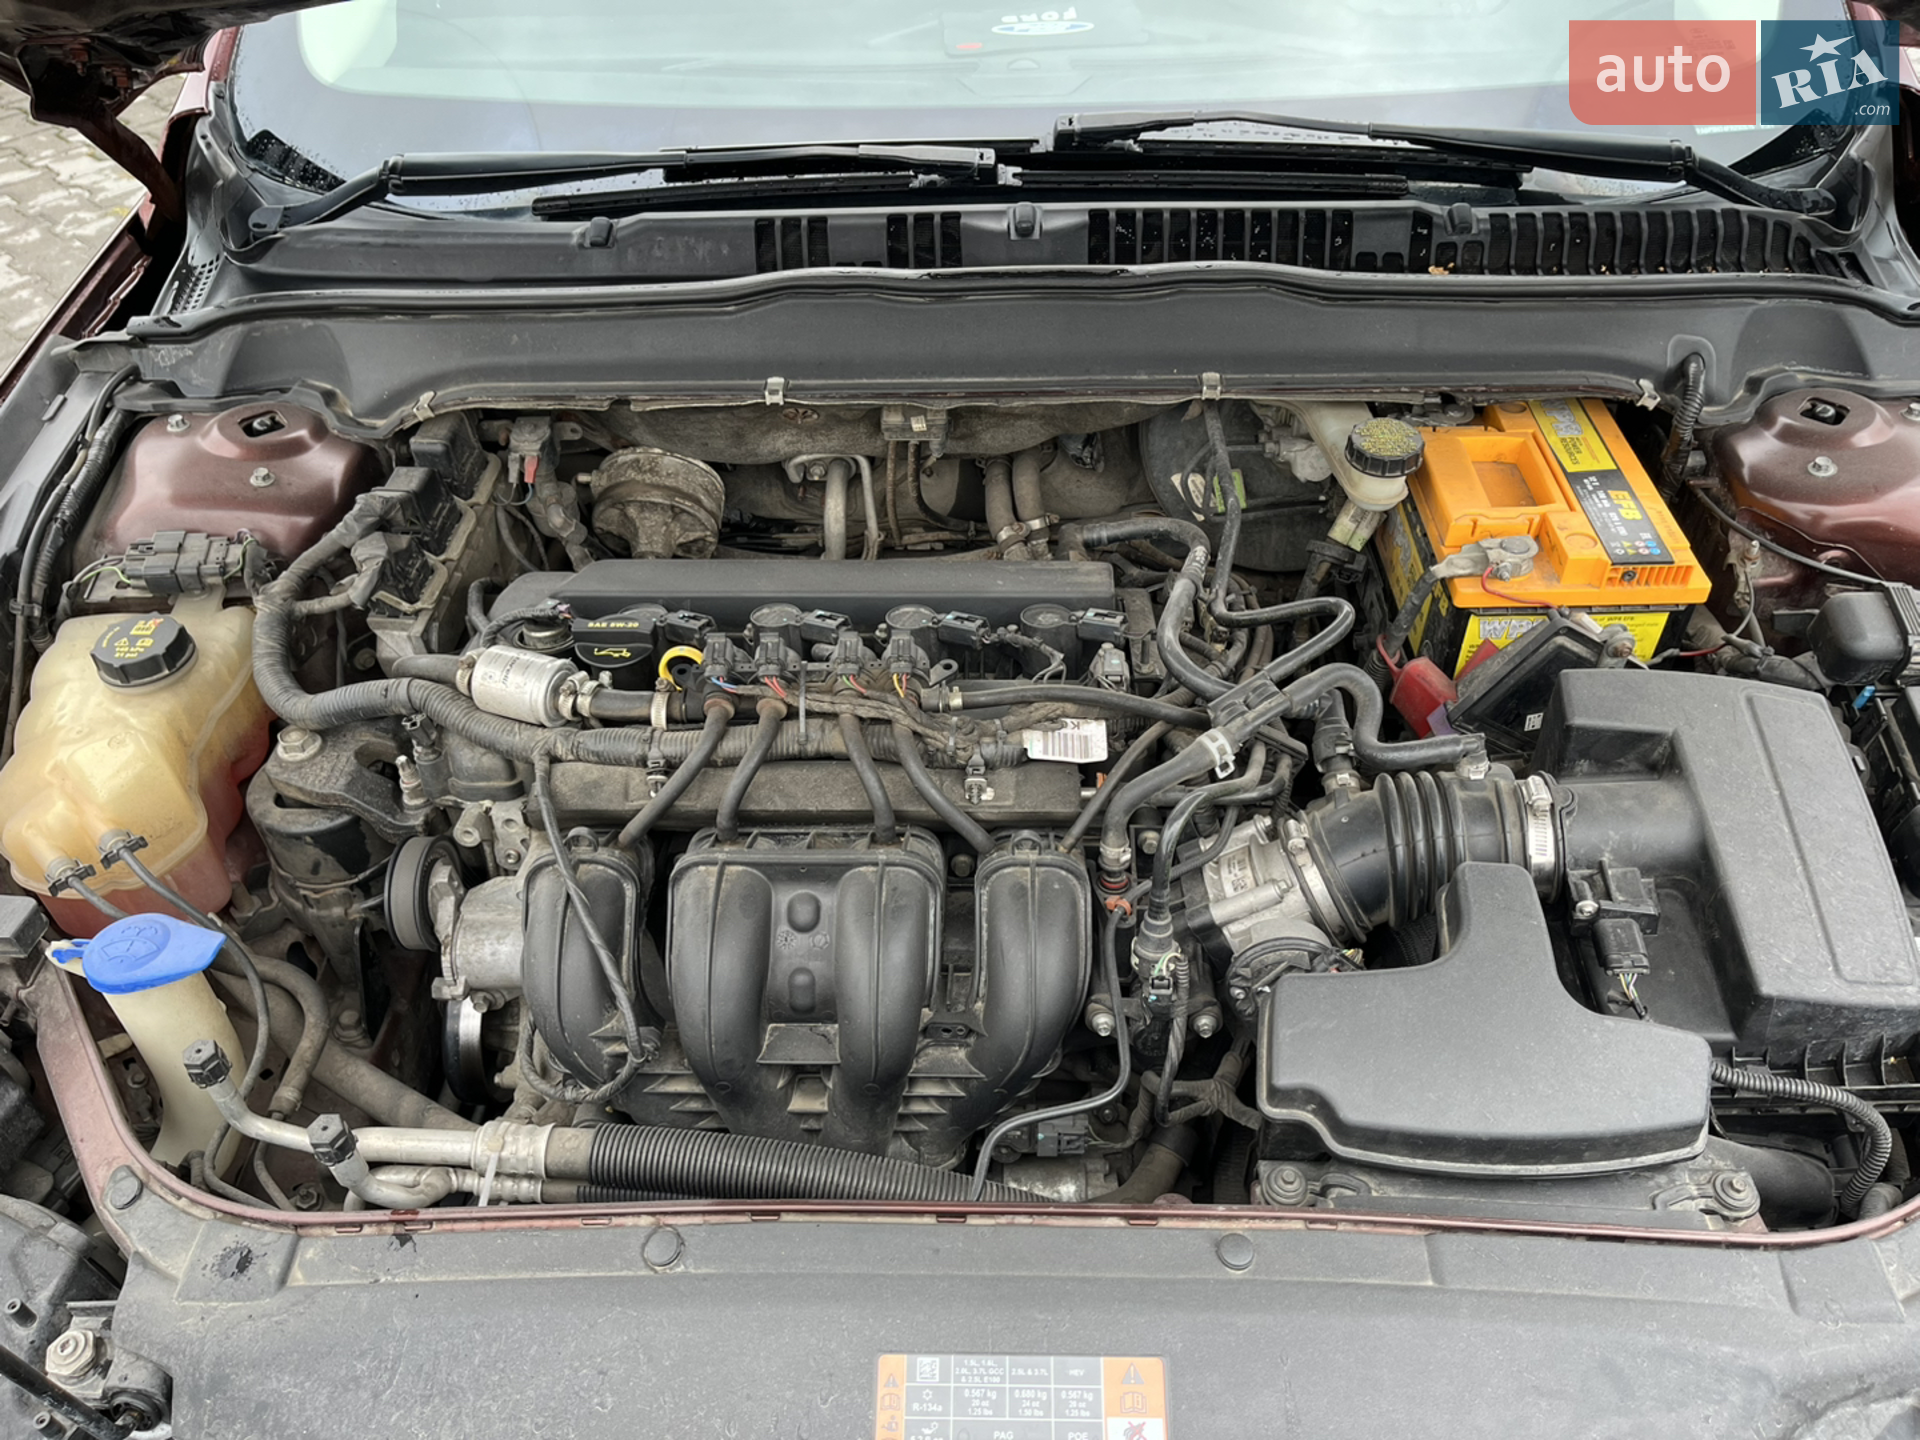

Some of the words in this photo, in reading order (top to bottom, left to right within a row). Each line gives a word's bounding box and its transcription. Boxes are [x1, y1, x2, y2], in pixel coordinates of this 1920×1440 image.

[1607, 490, 1643, 520] EFB
[1480, 618, 1546, 640] WP
[986, 1389, 997, 1400] kg
[1036, 1389, 1047, 1401] kg
[1083, 1391, 1094, 1402] kg
[912, 1402, 943, 1412] R-134a
[993, 1431, 1014, 1440] PAG
[1067, 1431, 1089, 1440] POE
